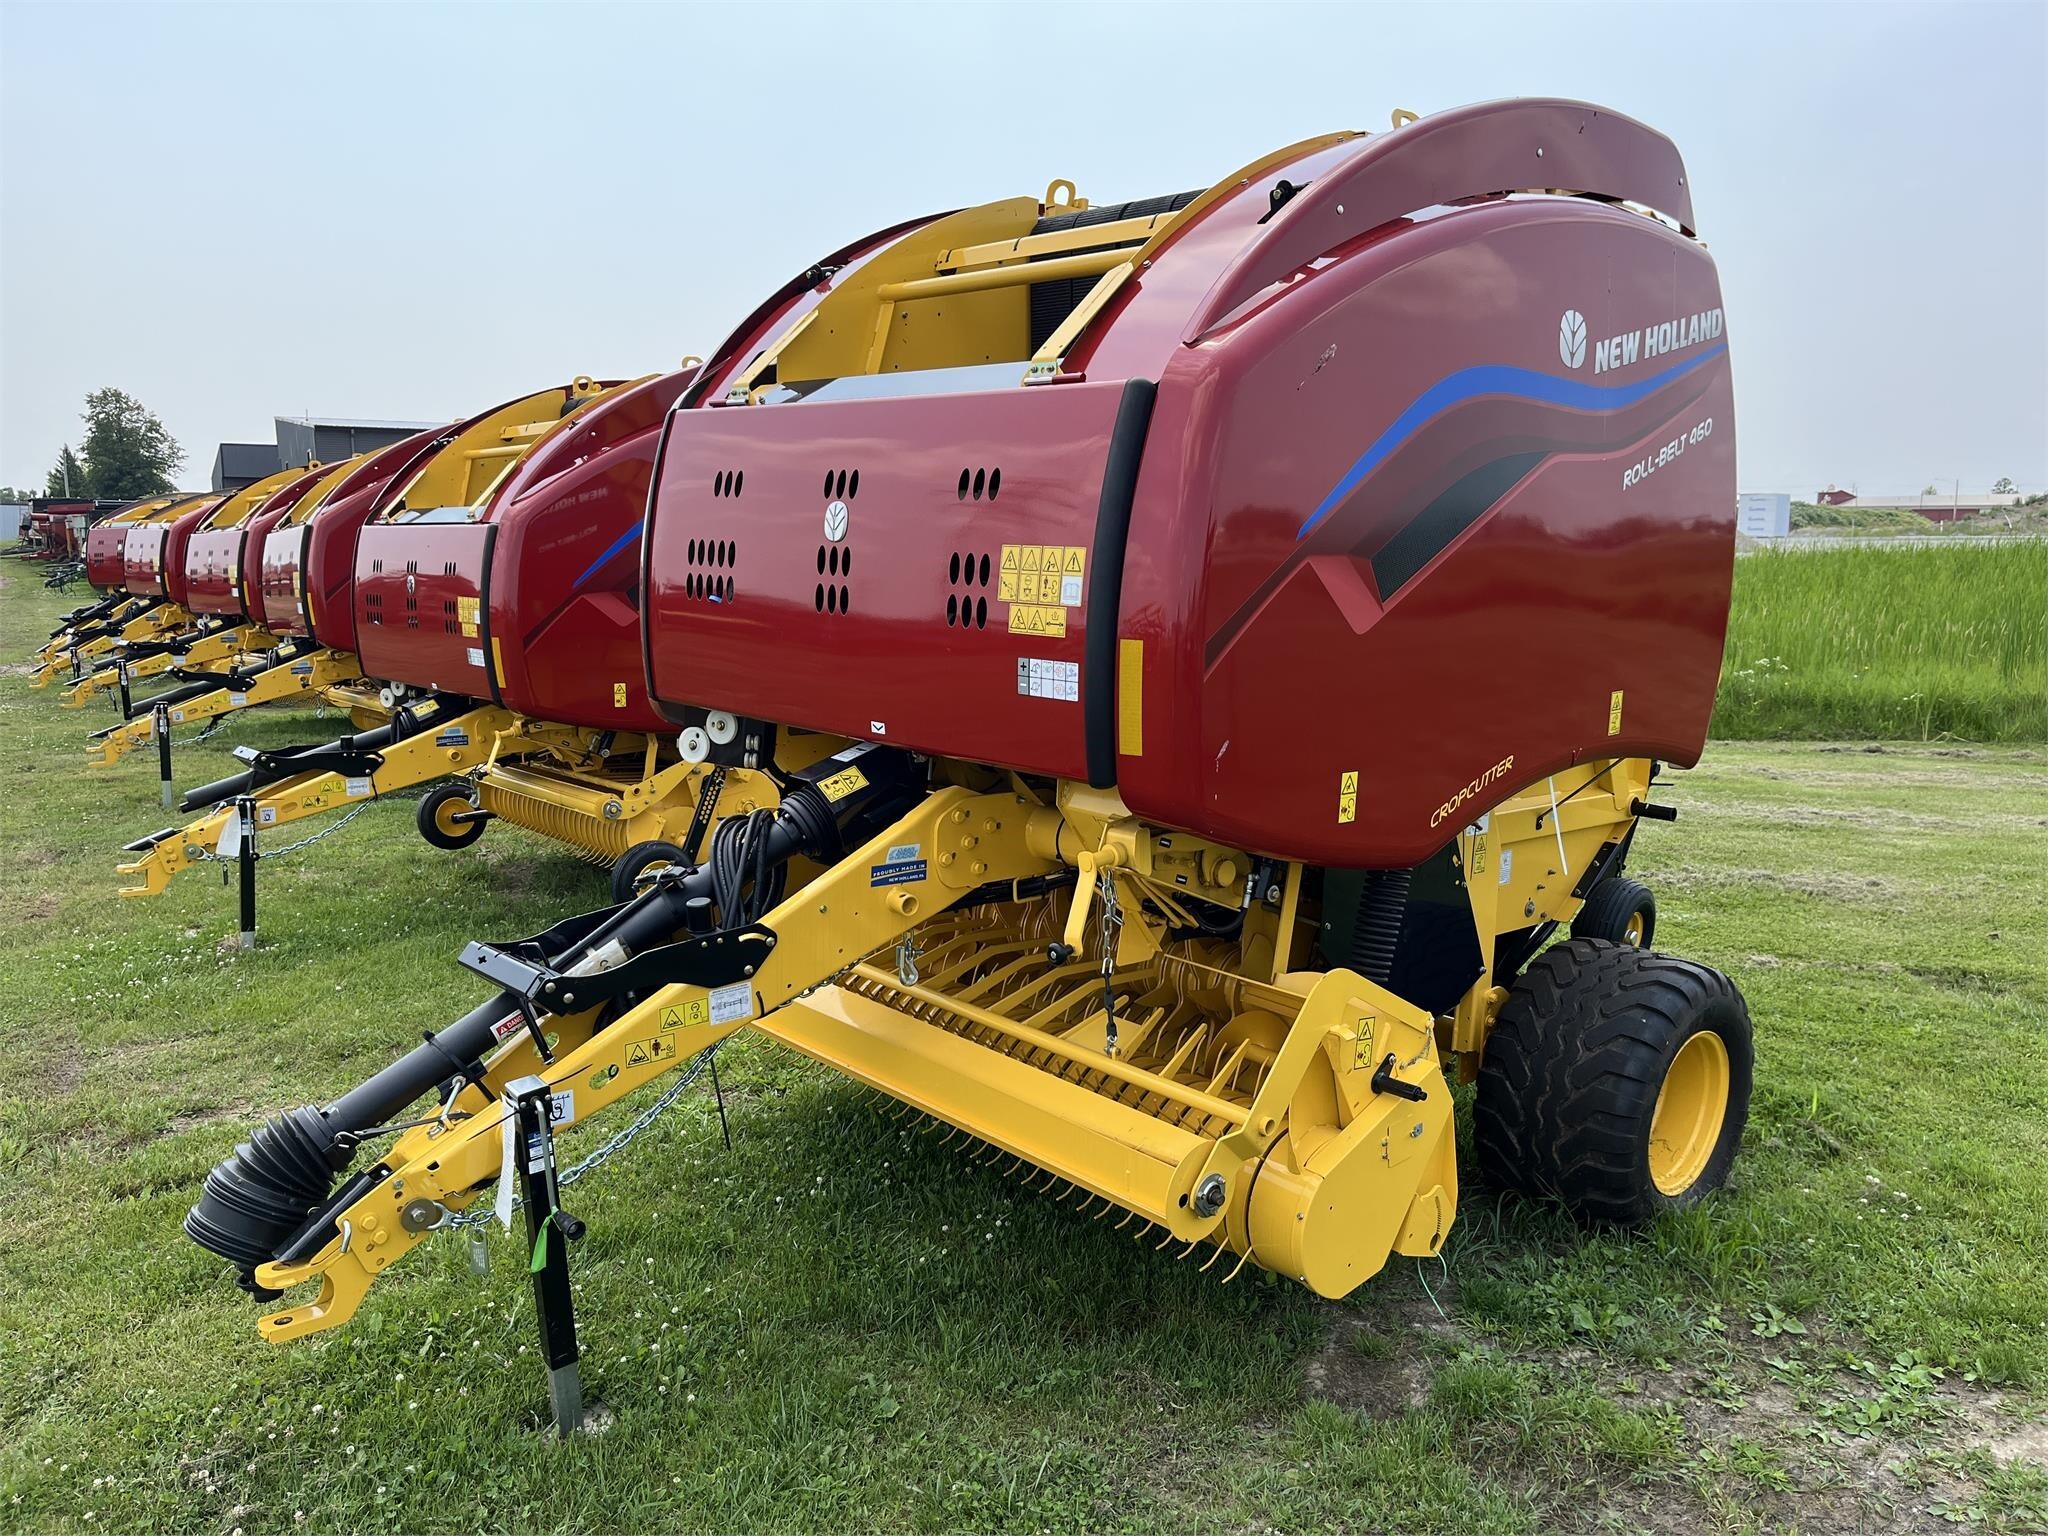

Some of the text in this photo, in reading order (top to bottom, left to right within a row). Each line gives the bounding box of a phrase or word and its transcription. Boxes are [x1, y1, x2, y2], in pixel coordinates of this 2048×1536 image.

[1594, 308, 1723, 374] NEW HOLLAND
[1622, 417, 1713, 491] ROLL-BELT 460
[1430, 754, 1514, 828] CROPCUTTER
[873, 867, 900, 877] PROUDLY
[507, 1013, 525, 1029] DANG
